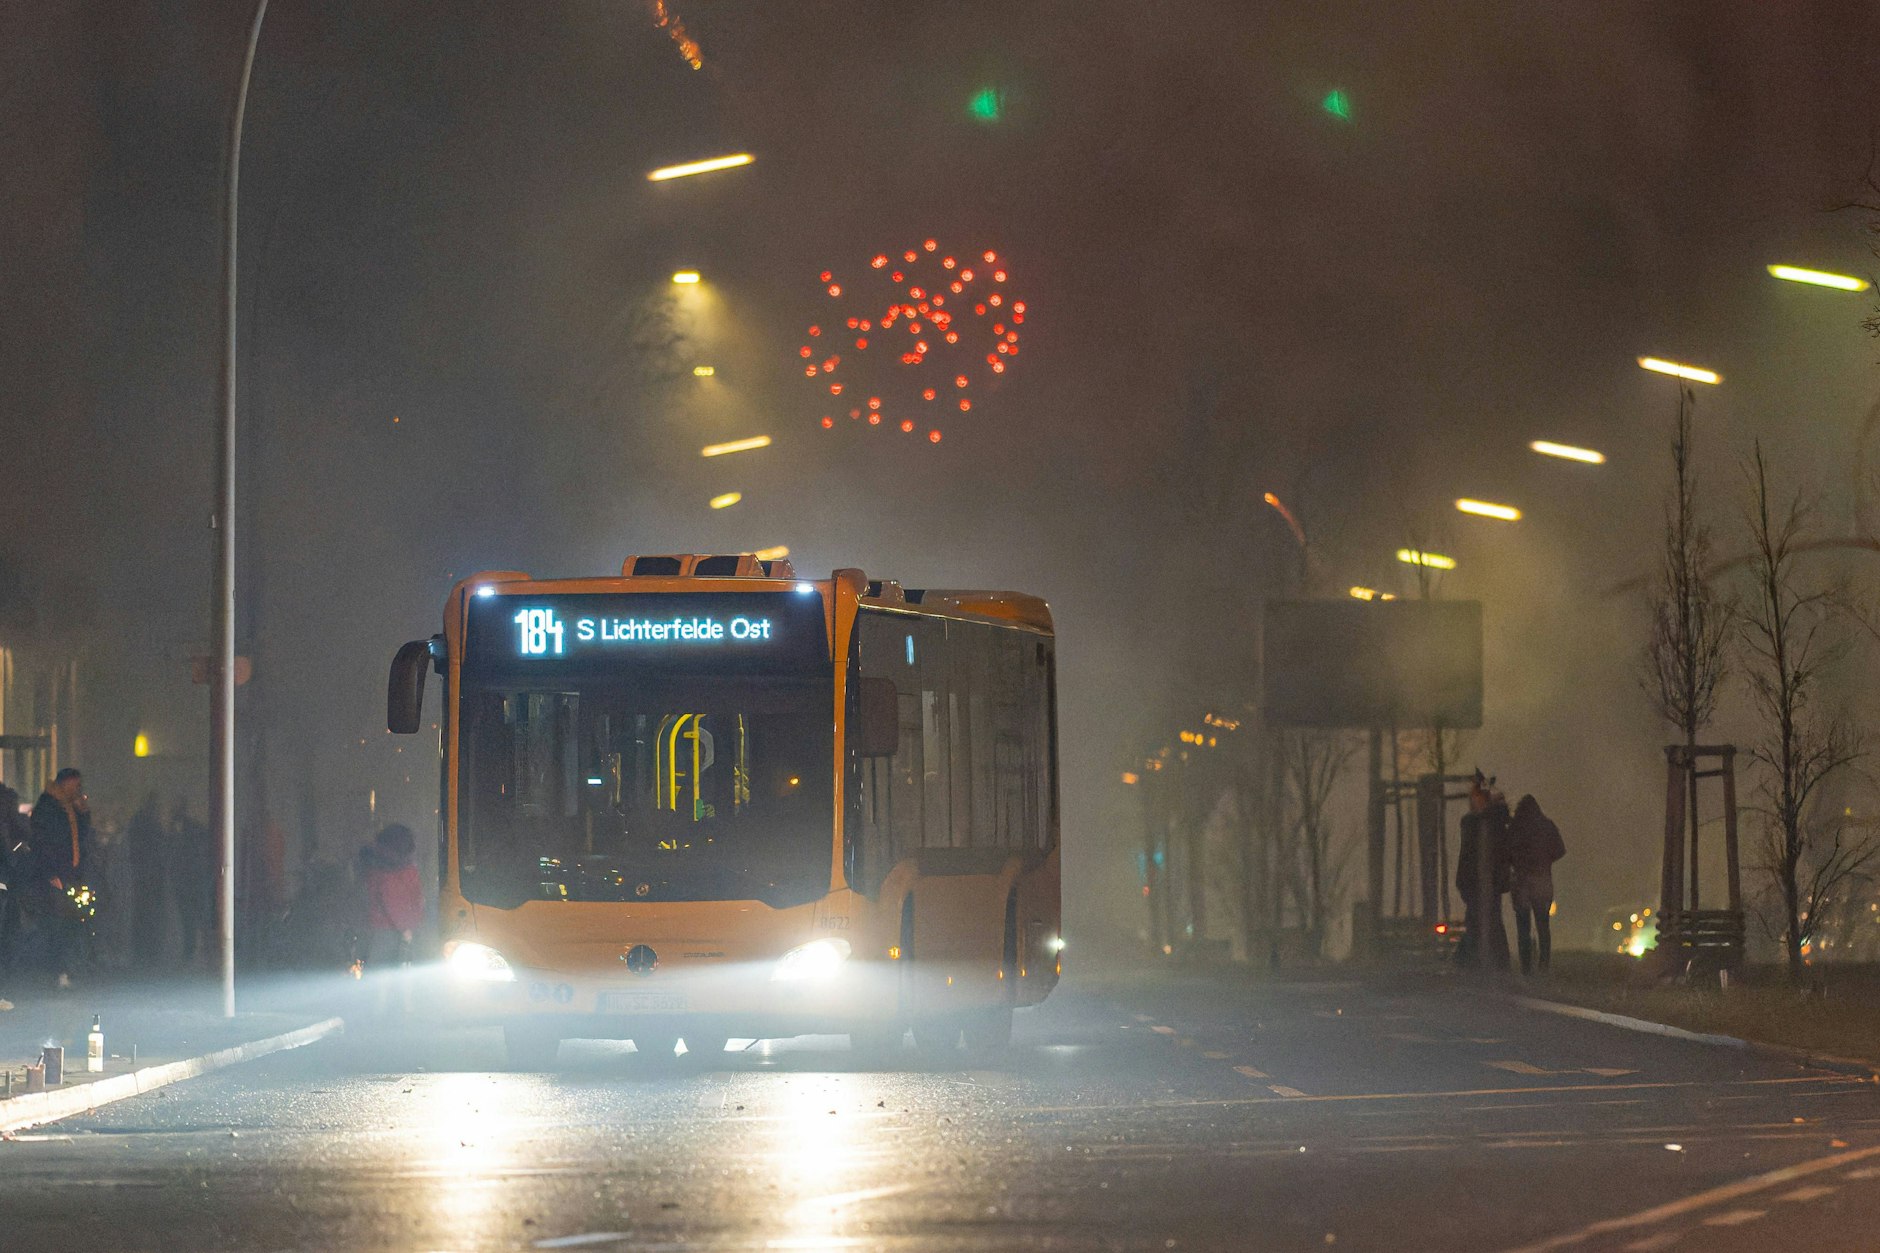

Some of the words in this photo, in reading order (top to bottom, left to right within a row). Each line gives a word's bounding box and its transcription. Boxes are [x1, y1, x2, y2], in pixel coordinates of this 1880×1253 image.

[514, 608, 564, 654] 184
[577, 618, 595, 641] S
[601, 618, 724, 641] Lichterfelde
[730, 617, 771, 640] Ost
